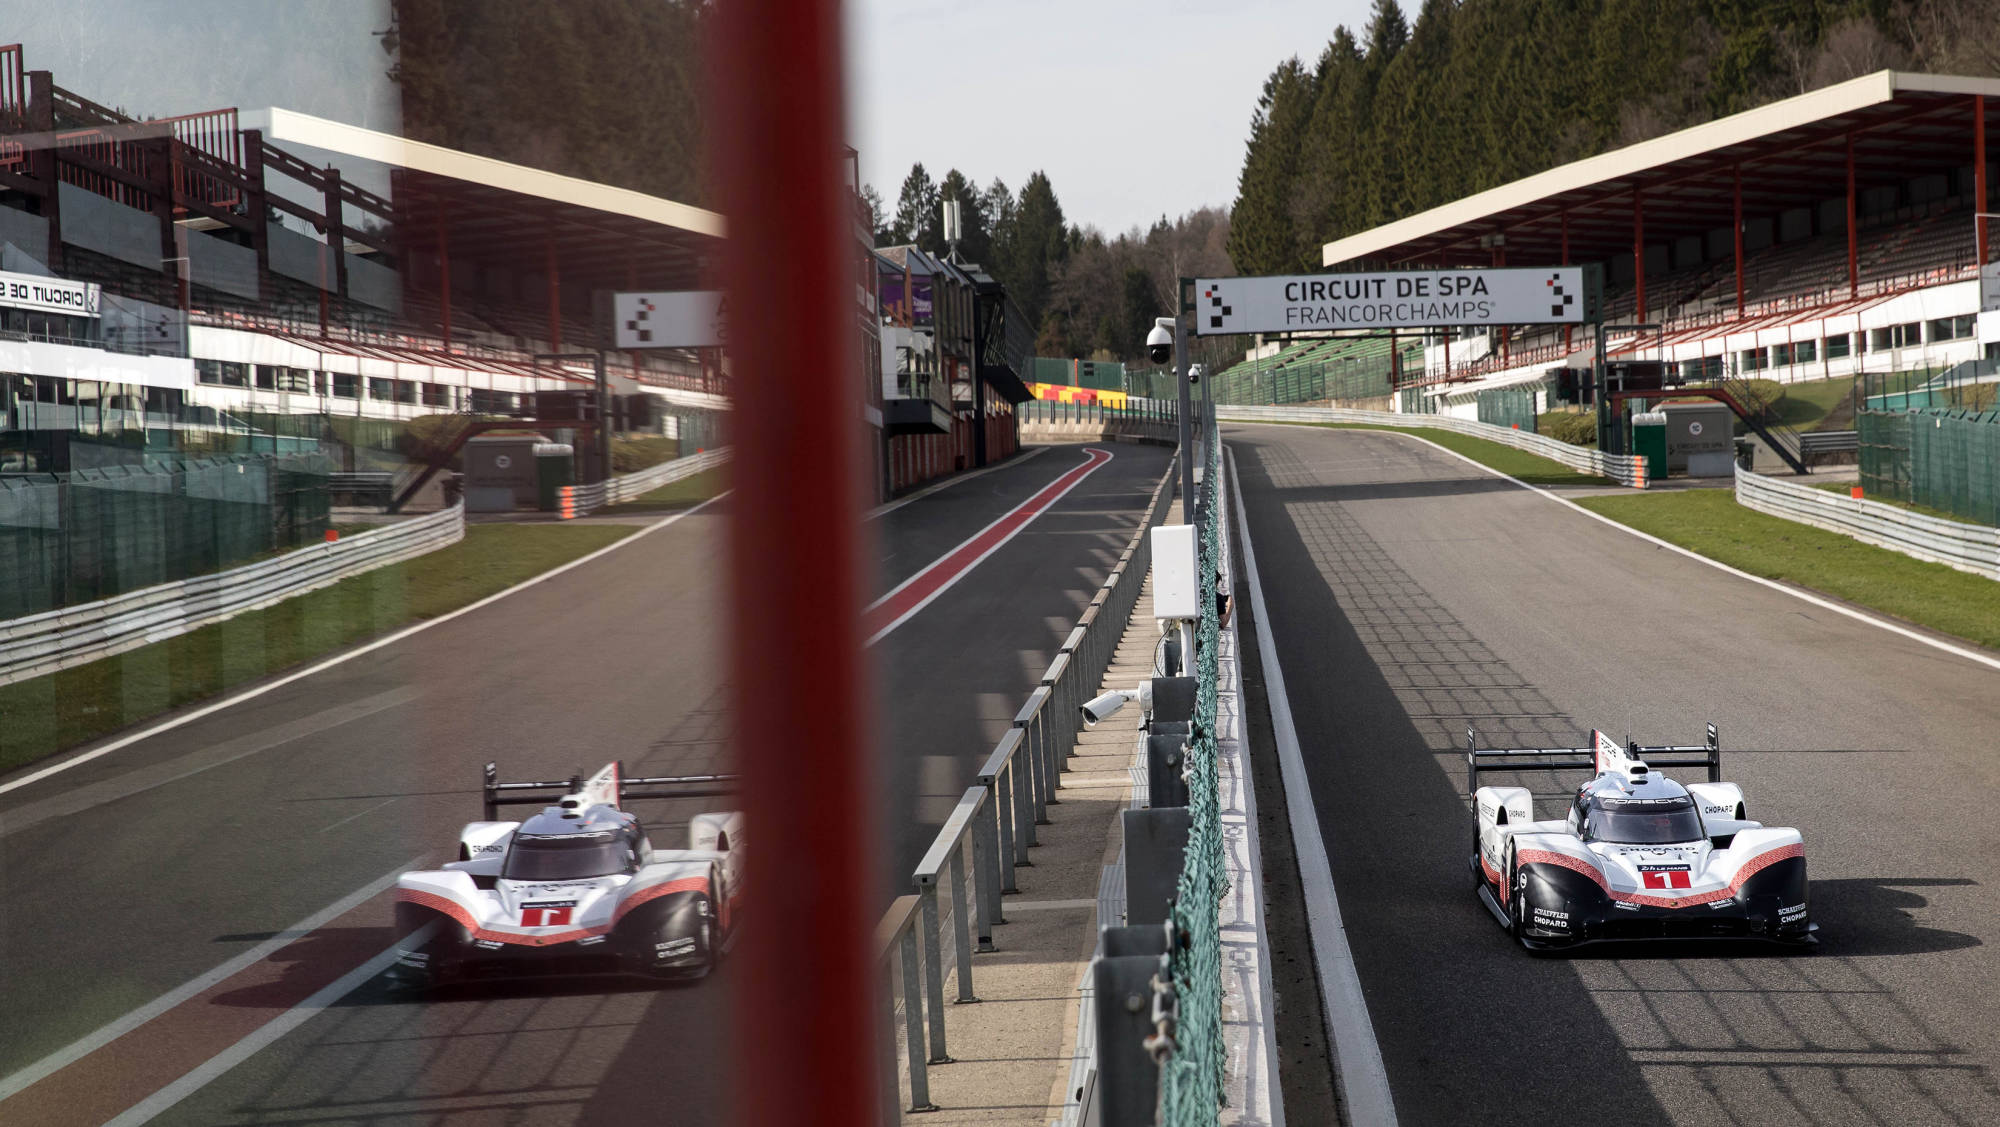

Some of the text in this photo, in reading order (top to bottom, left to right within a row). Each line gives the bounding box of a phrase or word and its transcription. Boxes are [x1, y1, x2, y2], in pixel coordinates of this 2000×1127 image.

[1284, 276, 1489, 302] CIRCUIT DE SPA
[1286, 301, 1491, 325] FRANCORCHAMPS
[1604, 797, 1689, 805] PORSCHE
[1508, 809, 1526, 818] CHOPARD
[1704, 804, 1733, 815] CHOPARD
[1654, 872, 1673, 889] 1
[1534, 907, 1569, 920] SCHAEFFLER
[1781, 910, 1807, 923] CHOPARD
[1534, 915, 1568, 928] CHOPARD
